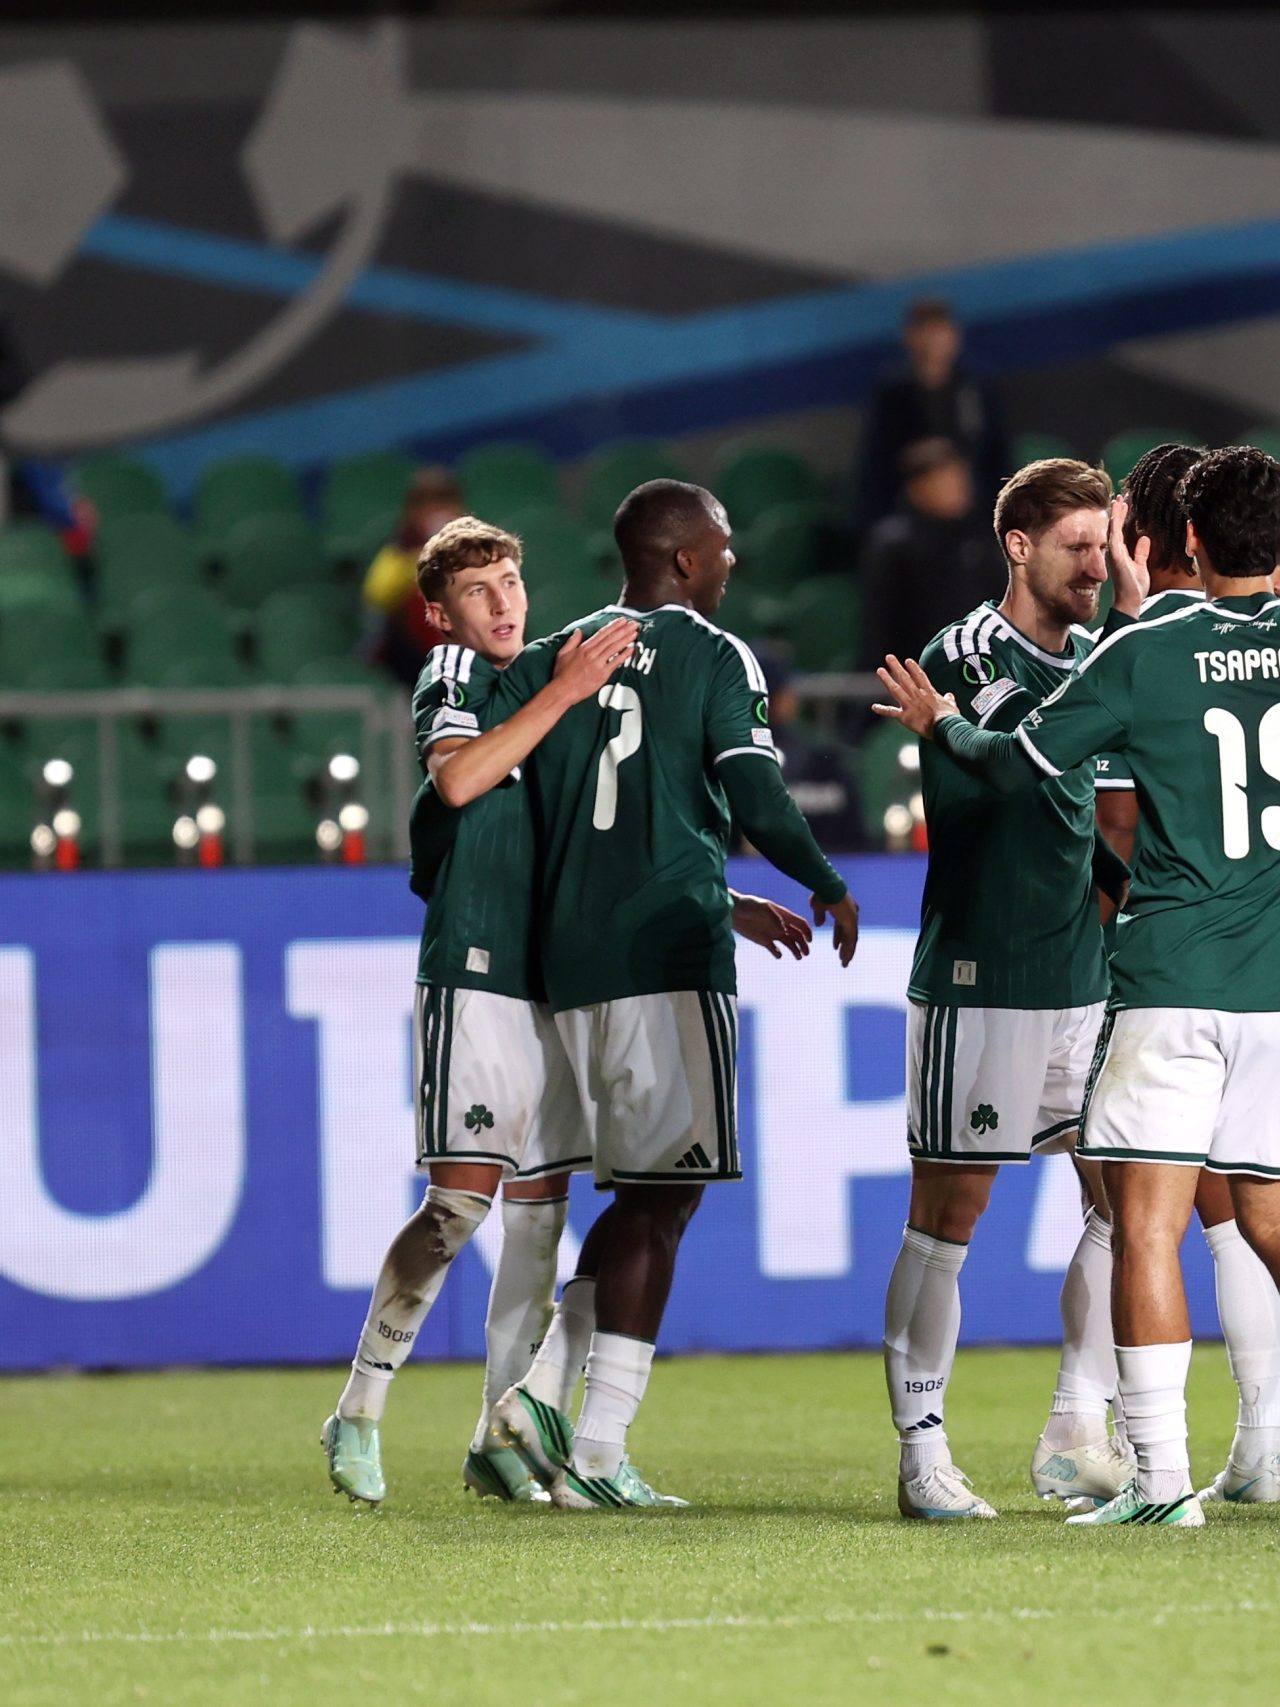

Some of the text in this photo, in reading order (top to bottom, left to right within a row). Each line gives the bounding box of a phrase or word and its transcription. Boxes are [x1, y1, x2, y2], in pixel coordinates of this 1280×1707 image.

[592, 682, 643, 831] 7
[376, 1320, 415, 1344] 1908
[904, 1376, 945, 1394] 1908
